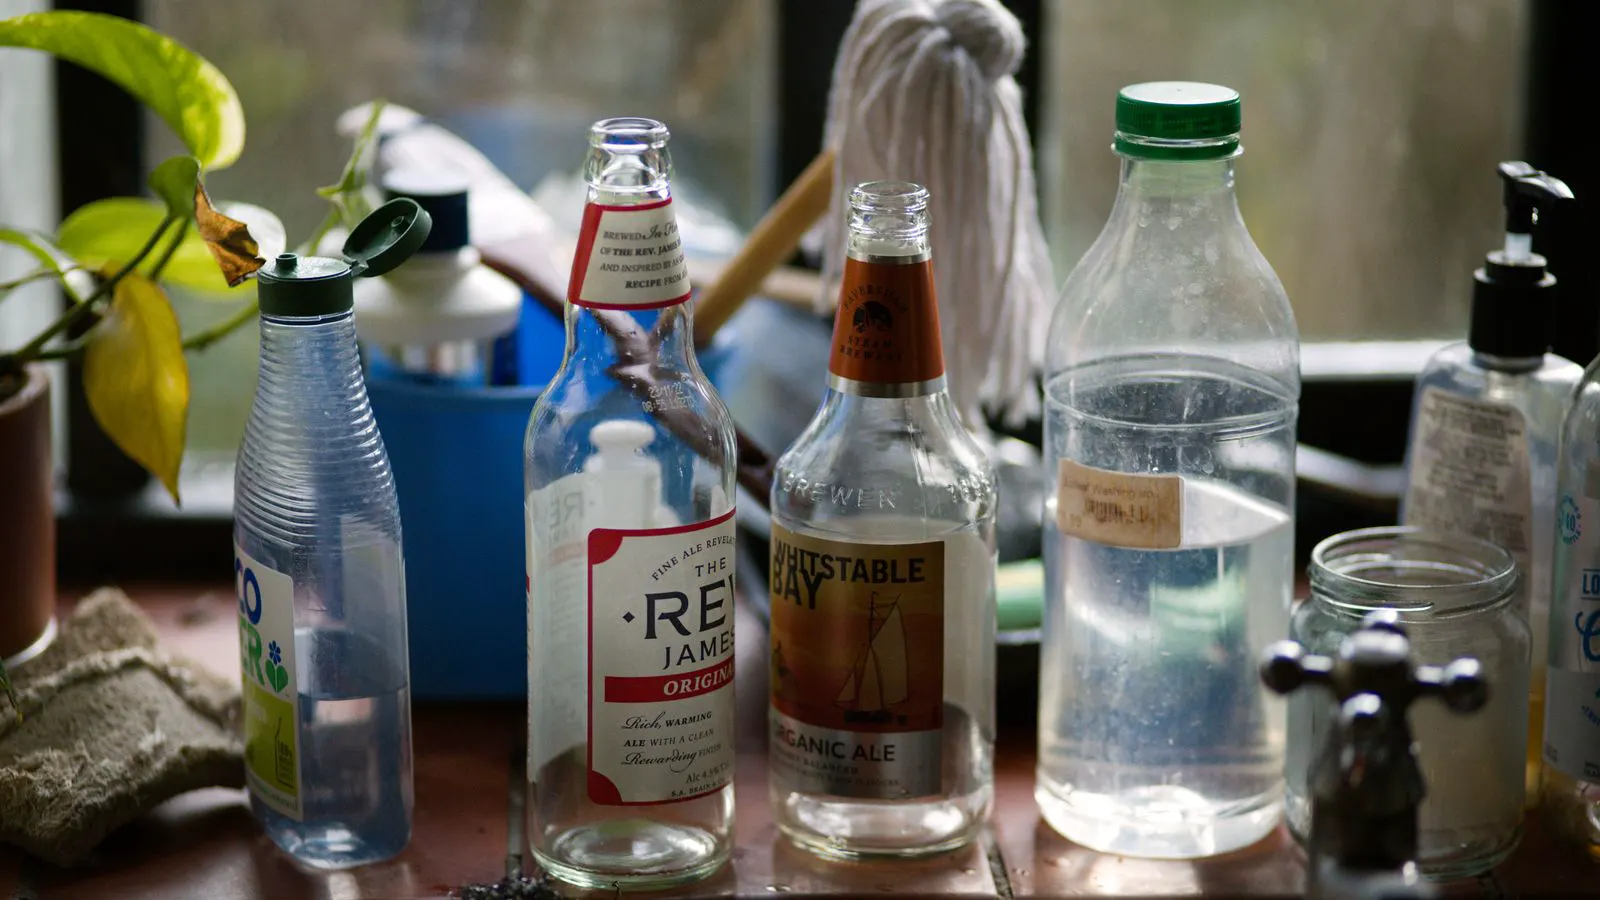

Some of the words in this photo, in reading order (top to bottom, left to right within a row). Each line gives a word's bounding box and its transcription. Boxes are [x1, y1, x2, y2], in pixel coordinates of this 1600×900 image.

[603, 231, 641, 241] BREWED
[600, 246, 611, 255] OF
[613, 247, 633, 256] THE
[635, 246, 656, 256] REV.
[600, 262, 620, 272] AND
[621, 262, 662, 272] INSPIRED
[662, 260, 671, 269] BY
[624, 278, 663, 289] RECIPE
[664, 273, 681, 286] FROM
[848, 335, 892, 348] STEAM
[651, 557, 679, 581] FINE
[682, 544, 703, 560] ALE
[695, 557, 726, 577] THE
[773, 537, 926, 584] WHITSTABLE
[773, 559, 824, 610] BAY
[621, 711, 666, 730] Rich,
[665, 711, 712, 728] WARMING
[624, 739, 645, 747] ALE
[650, 737, 676, 747] WITH
[679, 736, 686, 744] A
[688, 729, 714, 743] CLEAN
[621, 749, 697, 773] Rewarding
[698, 743, 722, 757] FINISH
[852, 744, 896, 762] ALE
[686, 772, 700, 784] Alc
